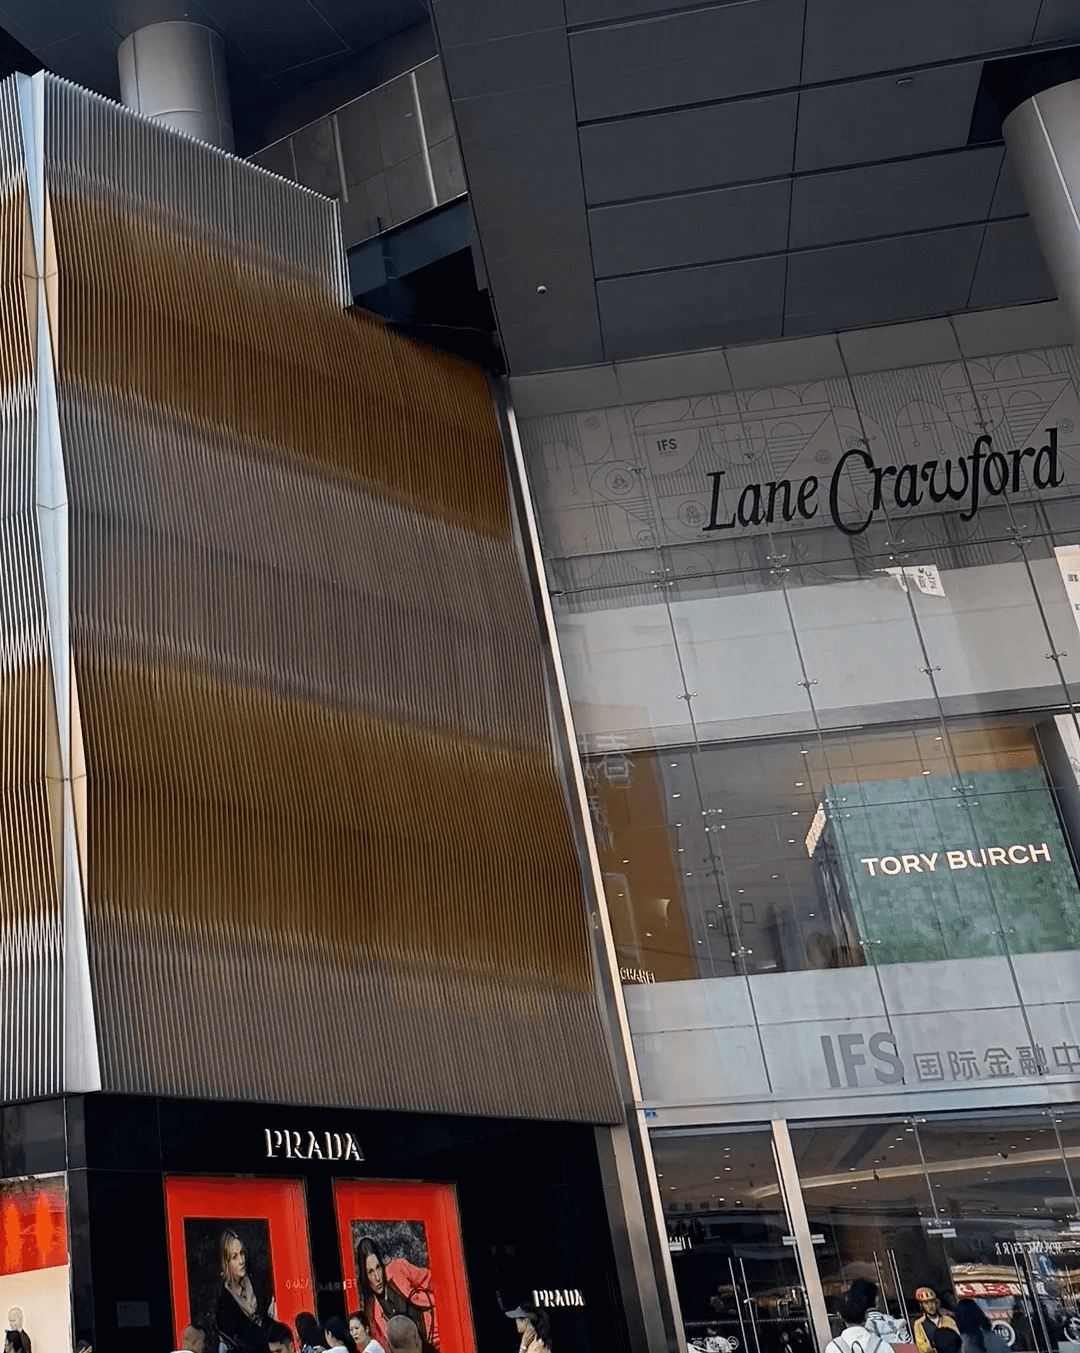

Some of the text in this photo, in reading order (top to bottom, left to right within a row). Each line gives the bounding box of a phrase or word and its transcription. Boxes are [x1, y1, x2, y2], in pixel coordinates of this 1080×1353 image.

[656, 438, 677, 452] IFS
[702, 428, 1065, 535] Lane Crawford
[861, 843, 1052, 877] TORY BURCH
[820, 1032, 905, 1088] IFS
[264, 1128, 364, 1161] PRADA
[532, 1289, 585, 1307] PRADA
